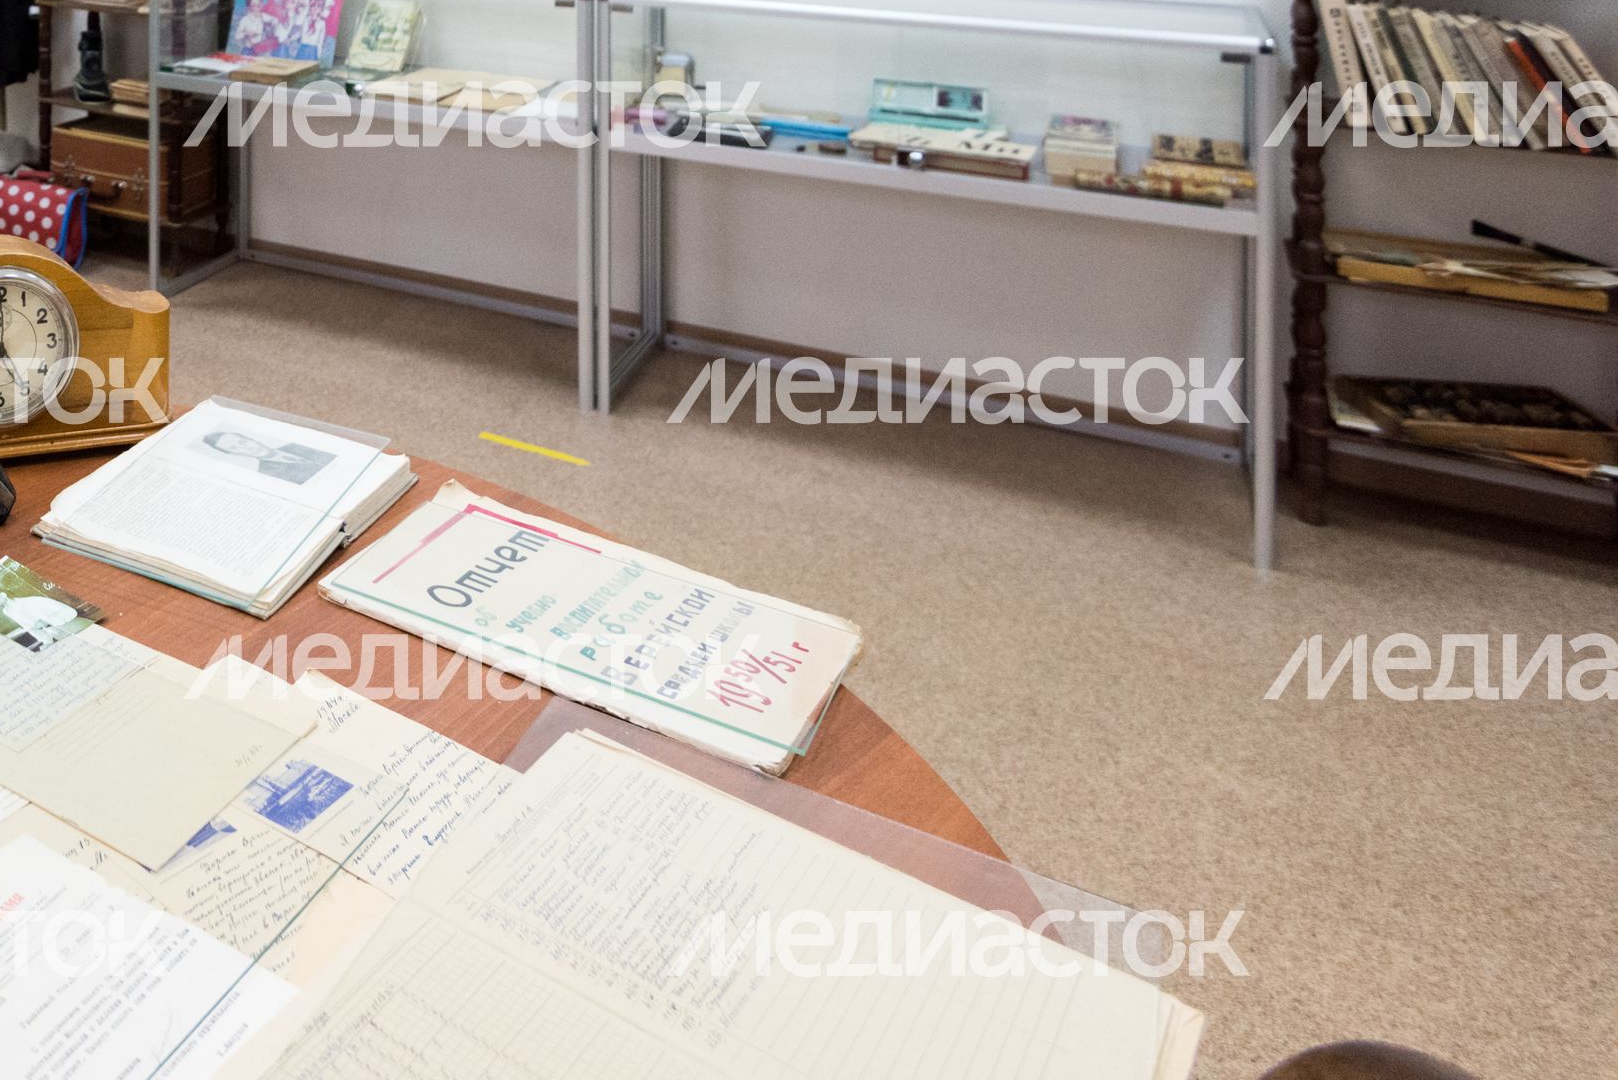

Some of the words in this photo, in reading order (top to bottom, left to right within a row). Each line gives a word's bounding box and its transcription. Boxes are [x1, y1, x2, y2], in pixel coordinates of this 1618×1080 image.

[36, 308, 48, 324] 2
[46, 333, 57, 349] 3
[37, 363, 48, 376] 4
[426, 530, 550, 608] Отчет
